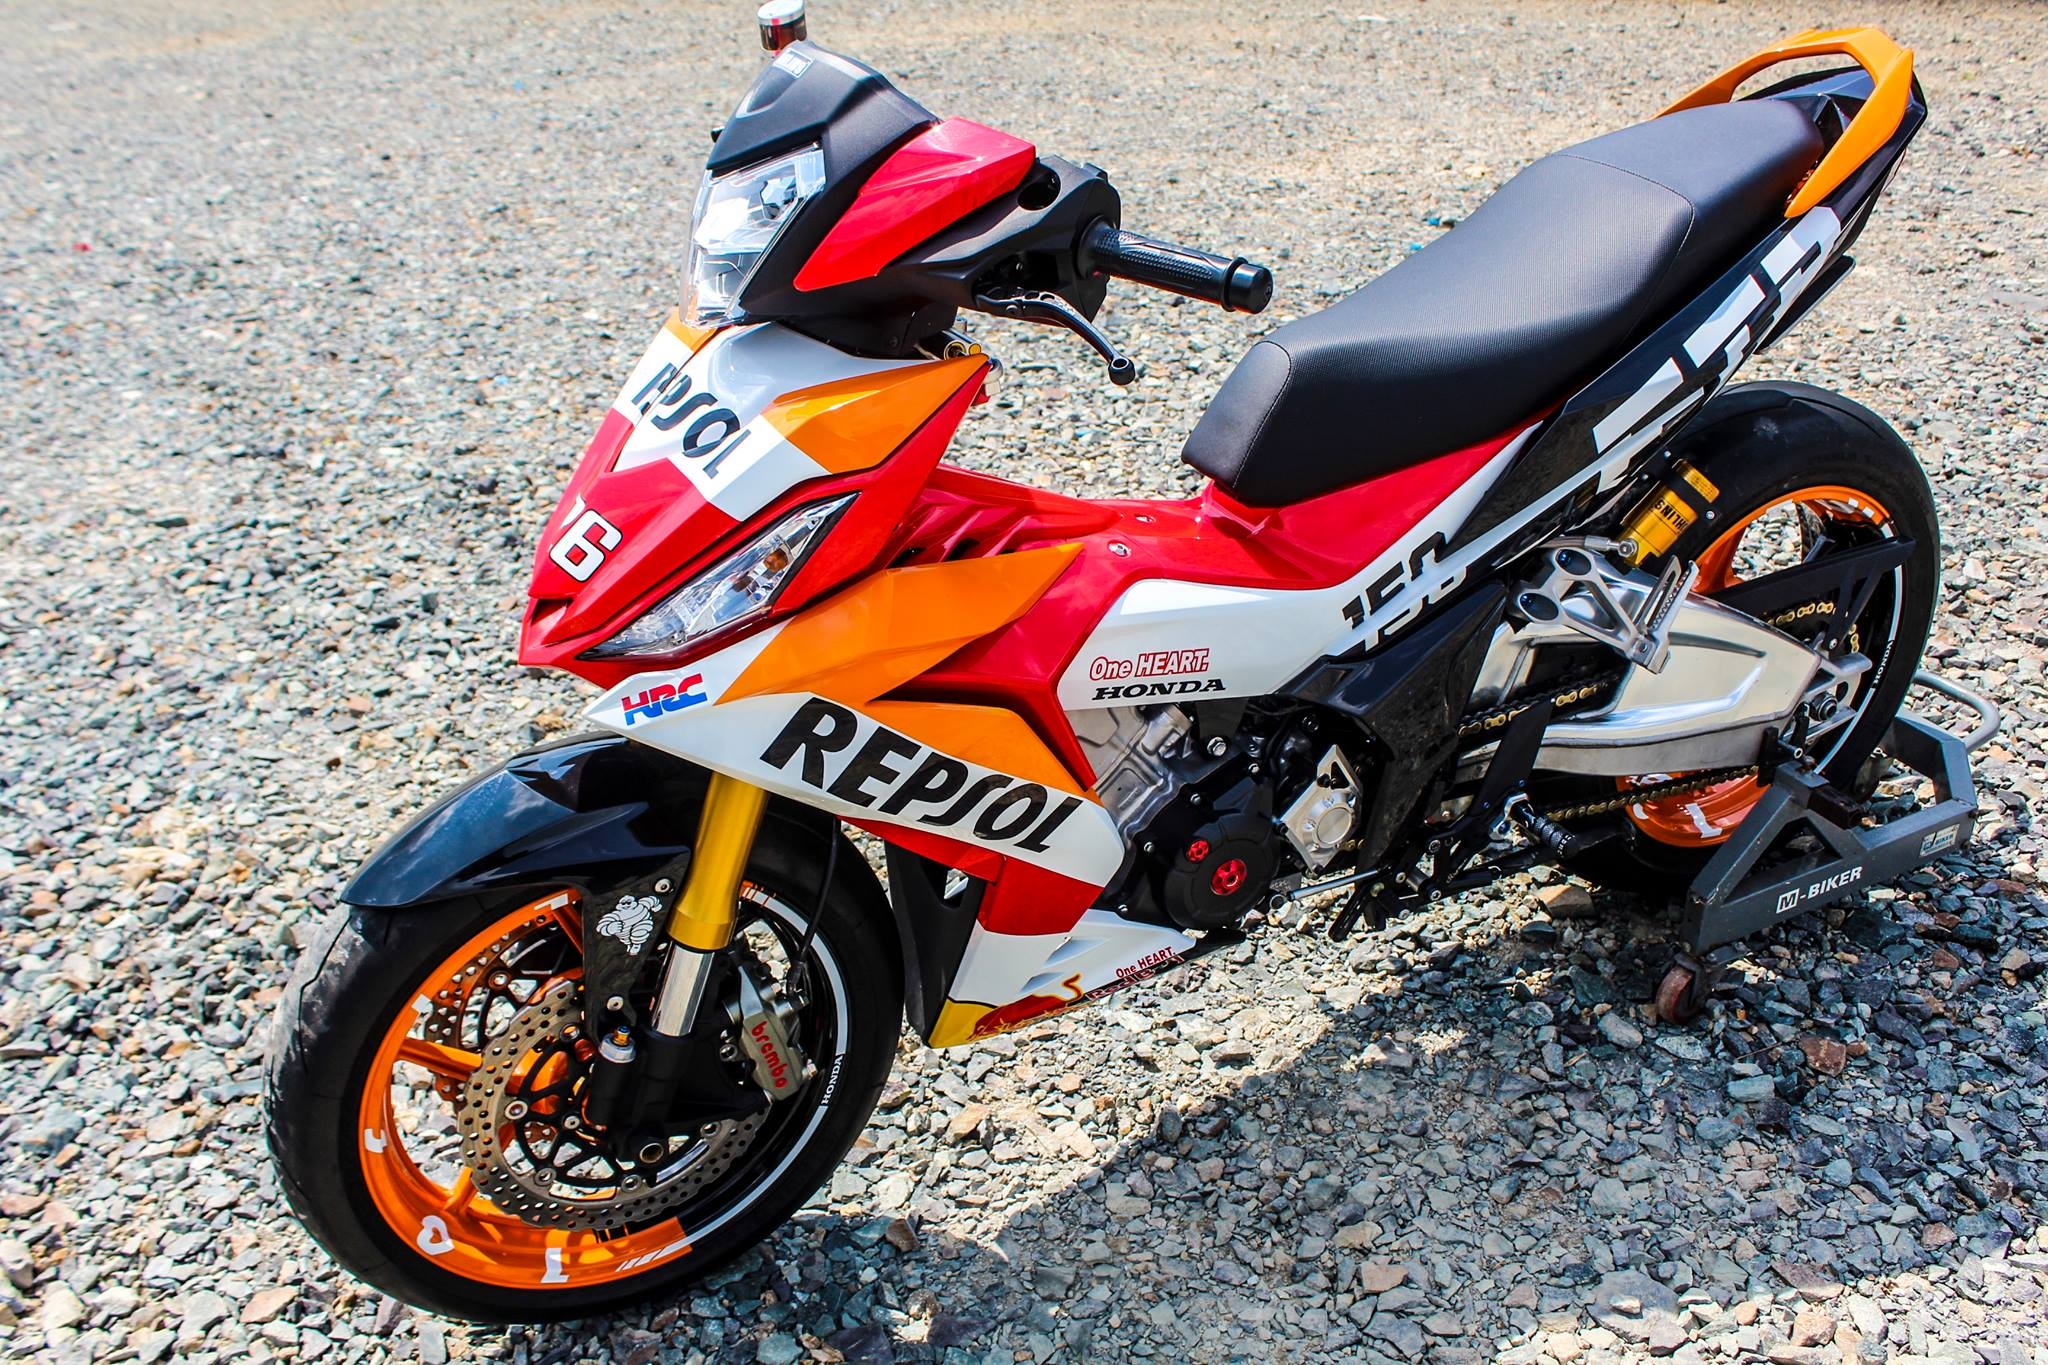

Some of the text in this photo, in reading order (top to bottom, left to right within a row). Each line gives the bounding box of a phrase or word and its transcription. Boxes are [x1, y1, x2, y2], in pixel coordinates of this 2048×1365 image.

[1653, 499, 1688, 533] HLINS
[1090, 648, 1210, 680] One HEART.
[621, 673, 708, 726] HRC
[1092, 678, 1226, 700] HONDA
[760, 697, 1083, 853] REPSOL
[1116, 946, 1176, 978] One HEART.
[751, 1021, 788, 1089] brembo
[821, 1054, 843, 1105] HONDA
